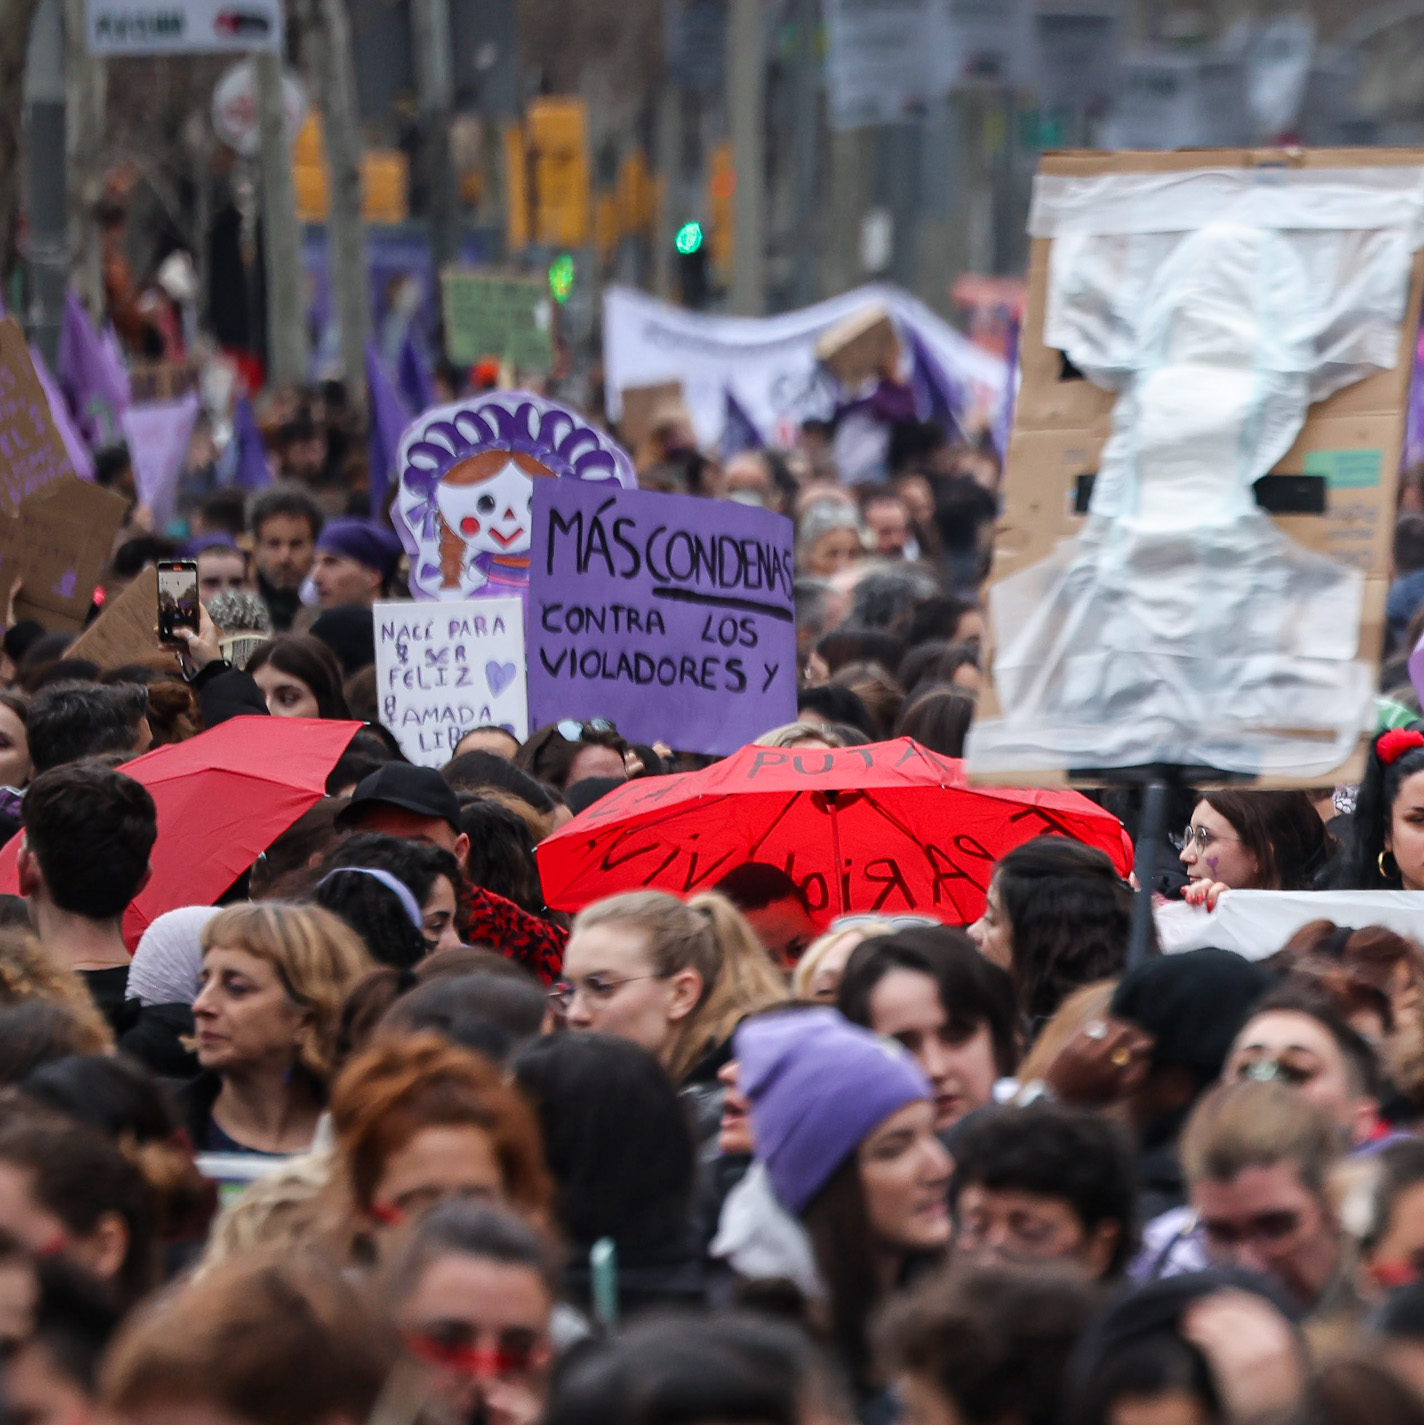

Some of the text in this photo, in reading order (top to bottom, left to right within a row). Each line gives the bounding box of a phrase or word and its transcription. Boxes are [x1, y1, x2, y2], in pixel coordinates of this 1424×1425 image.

[547, 497, 795, 602] MÁS CONDENAS
[449, 615, 507, 640] PARA
[541, 603, 758, 649] CONTRA LOS
[424, 645, 467, 669] SER
[539, 647, 748, 694] VIOLADORES
[389, 665, 474, 690] FELIZ
[402, 703, 493, 728] AMADA
[747, 745, 950, 779] PUTA
